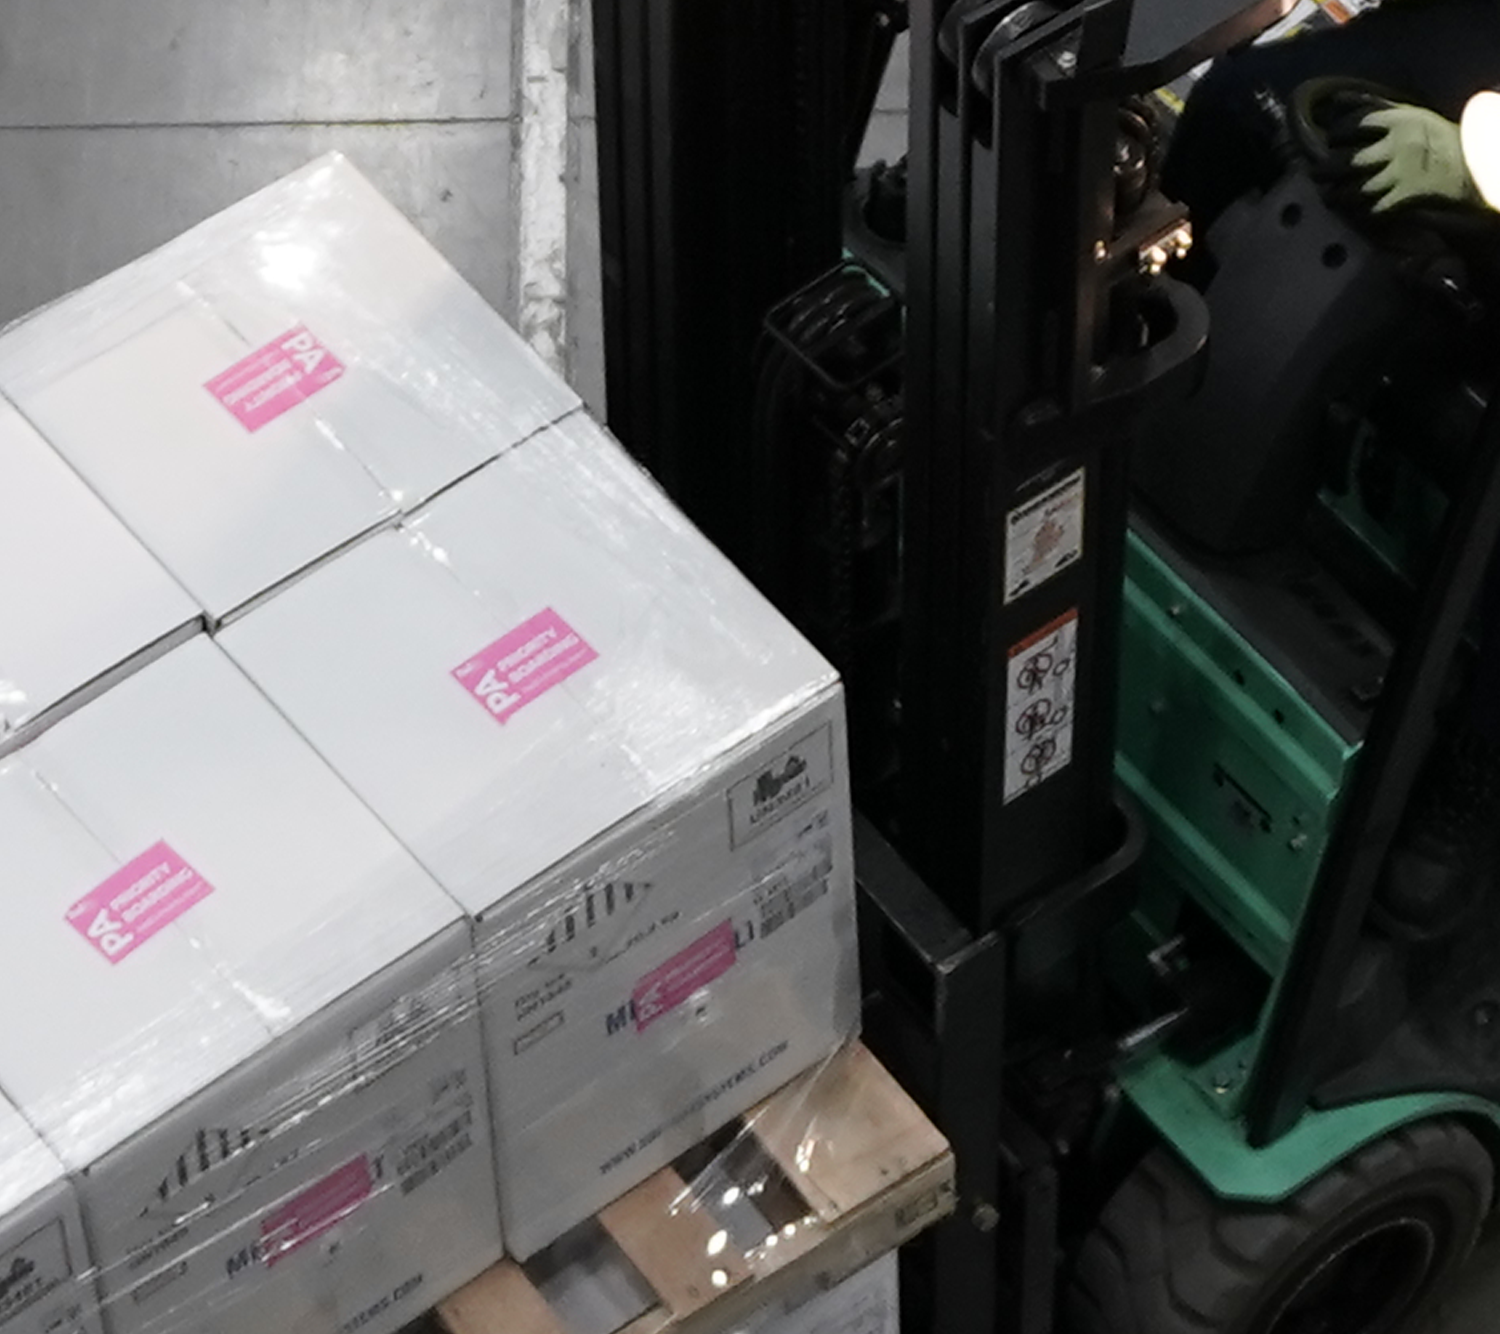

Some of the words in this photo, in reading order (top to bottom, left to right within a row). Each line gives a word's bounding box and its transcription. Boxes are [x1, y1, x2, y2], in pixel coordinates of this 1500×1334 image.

[281, 331, 326, 374] PA
[474, 669, 522, 715] PA
[87, 907, 134, 956] PA
